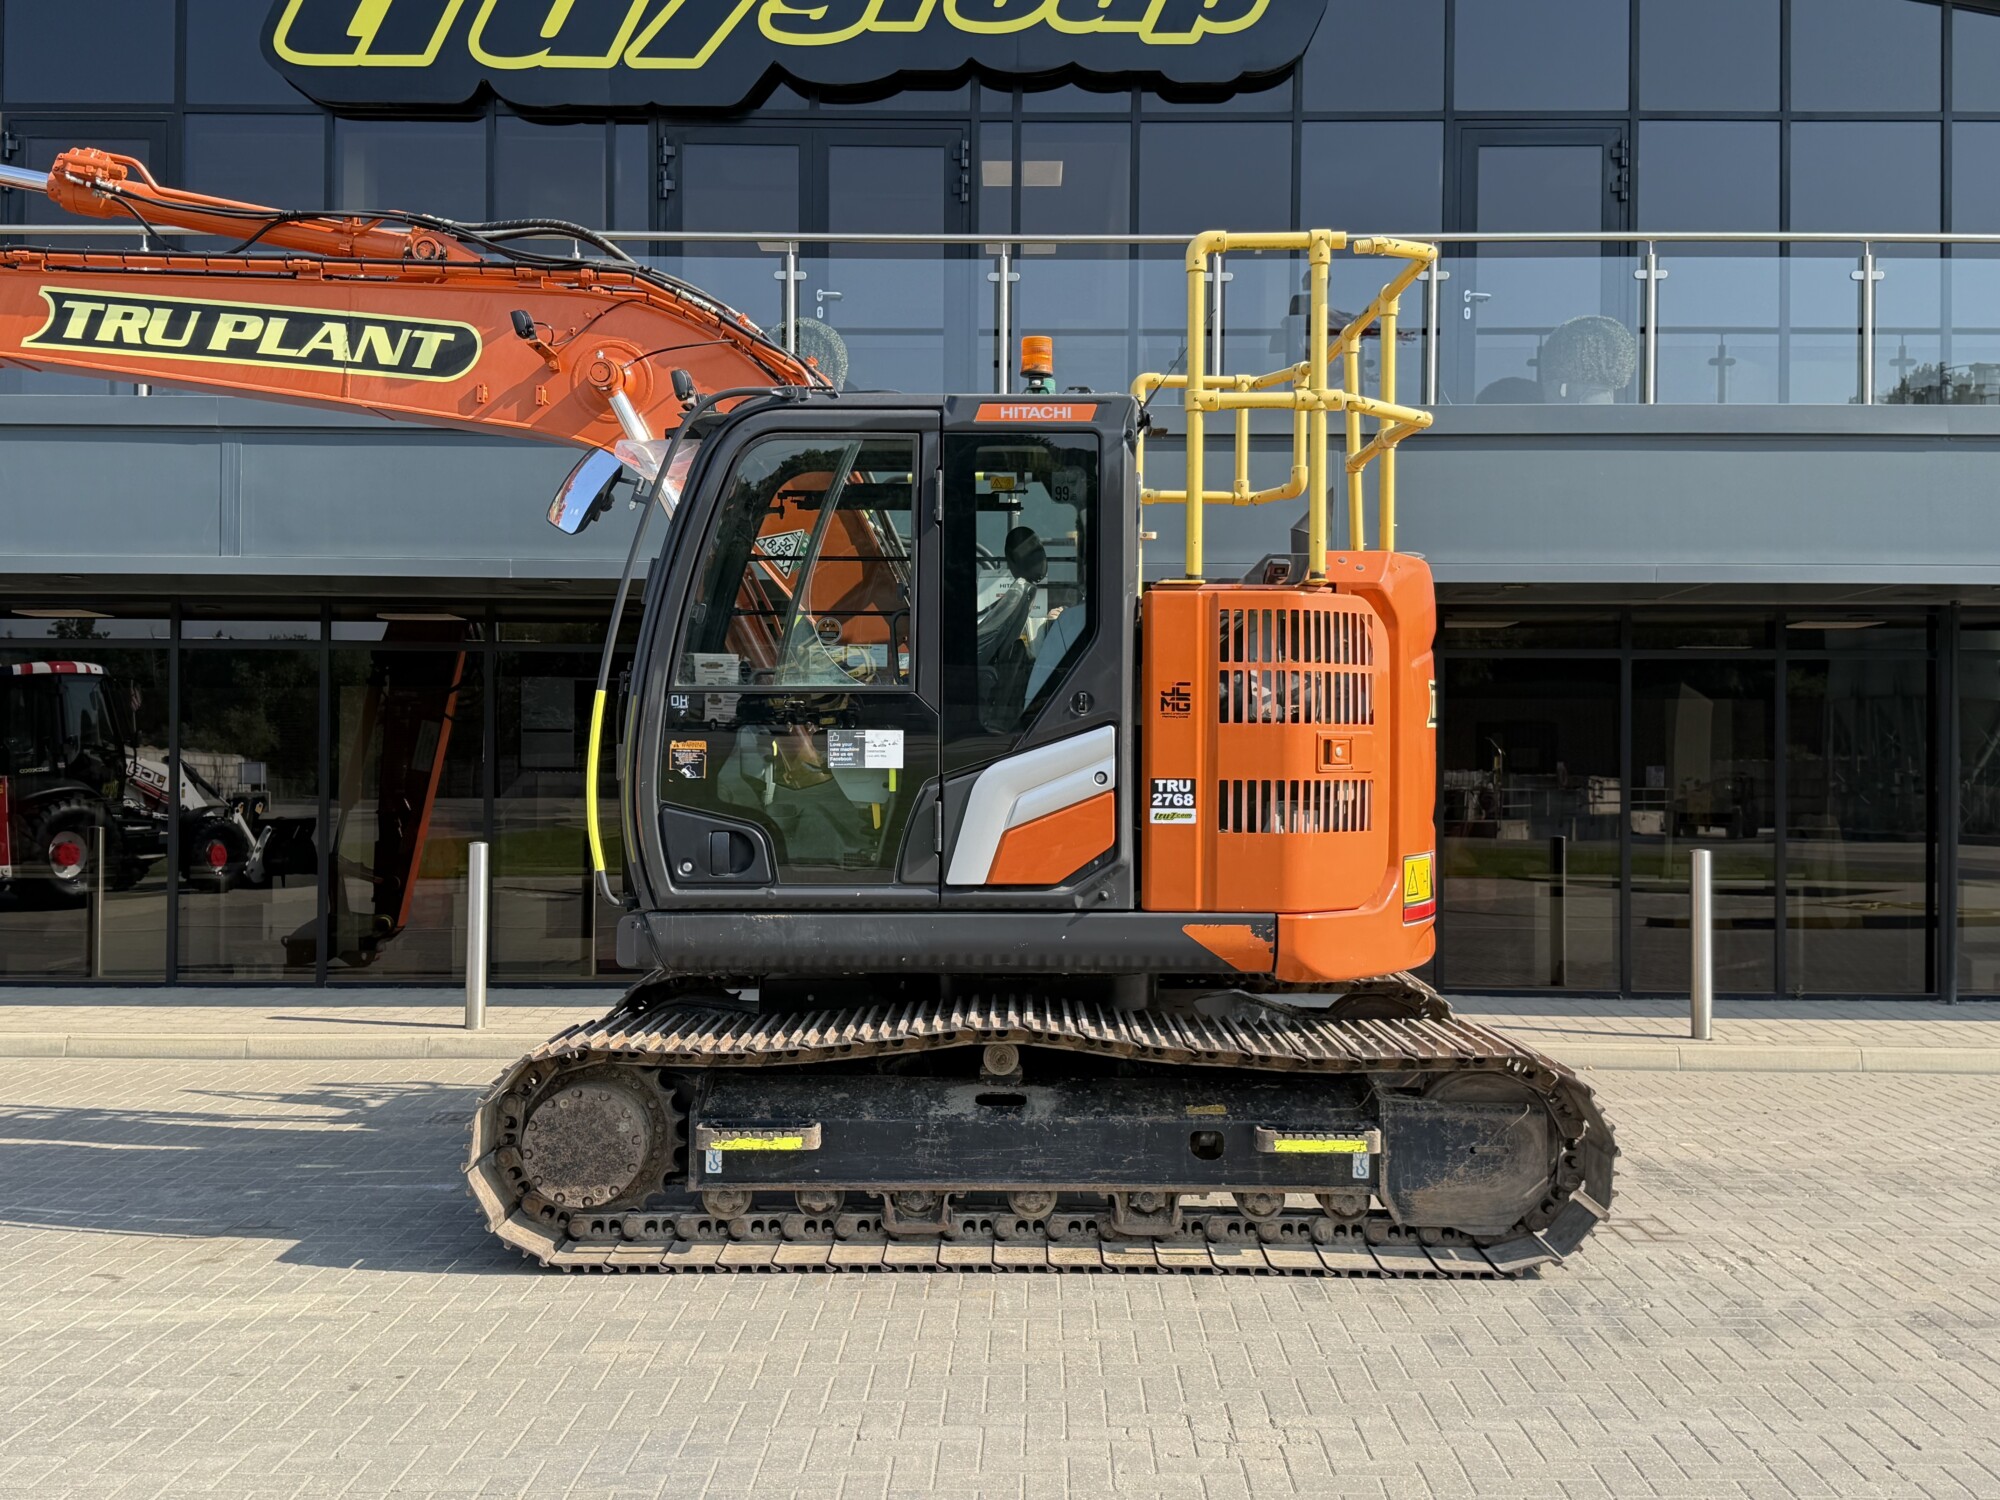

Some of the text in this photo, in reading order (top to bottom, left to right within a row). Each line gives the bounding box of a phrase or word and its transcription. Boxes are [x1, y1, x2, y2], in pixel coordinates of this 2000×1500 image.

[62, 300, 456, 370] TRU PLANT
[1000, 406, 1072, 419] HITACHI
[1055, 486, 1070, 501] 99
[780, 537, 793, 551] 56
[1154, 779, 1192, 792] TRU
[1152, 793, 1195, 807] 2768
